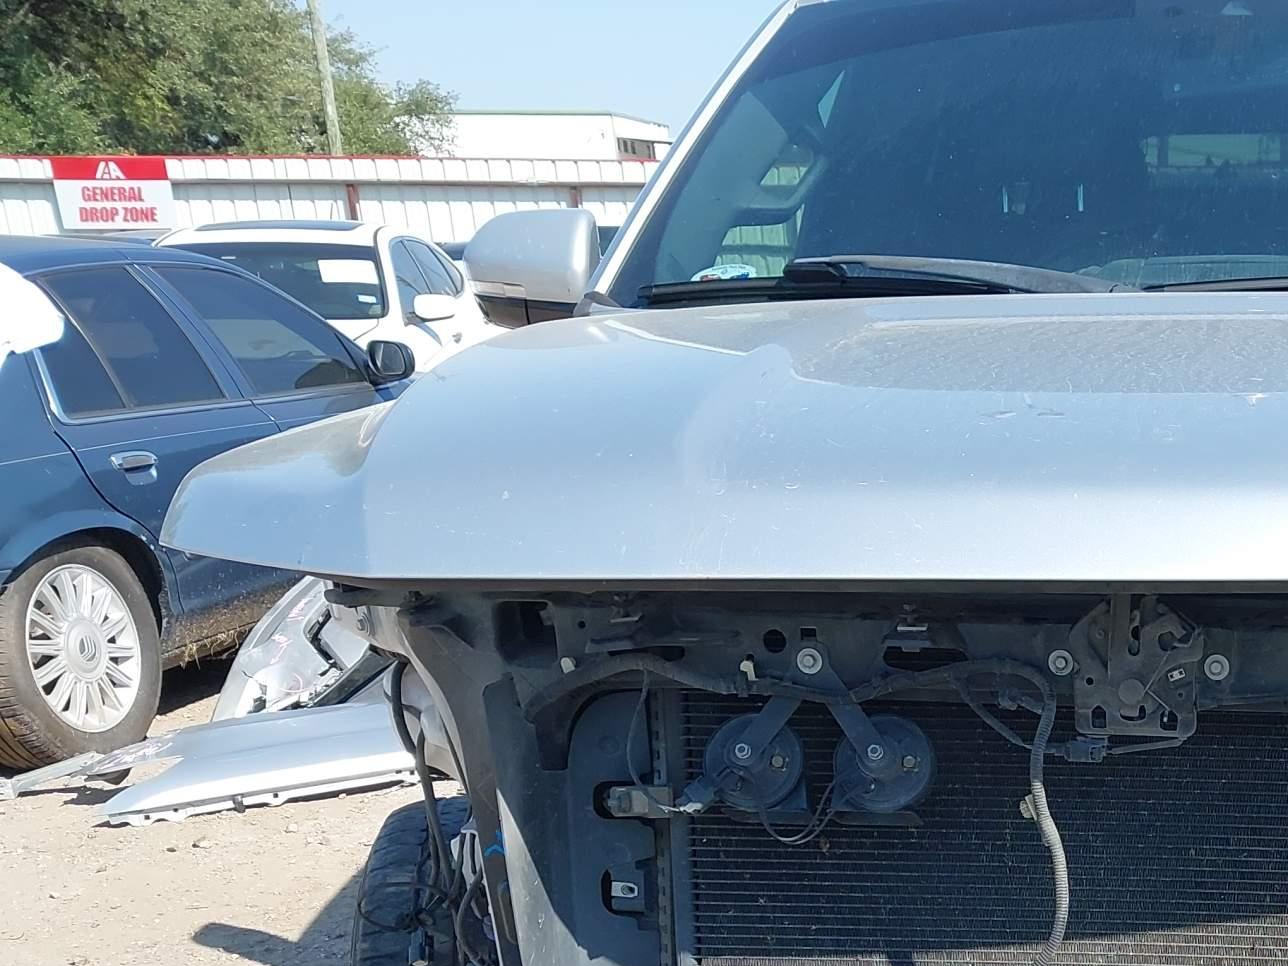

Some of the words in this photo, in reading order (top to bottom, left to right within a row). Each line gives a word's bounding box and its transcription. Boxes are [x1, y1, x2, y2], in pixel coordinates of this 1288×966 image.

[81, 186, 144, 203] GENERAL
[79, 206, 119, 223] DROP
[121, 206, 158, 223] ZONE
